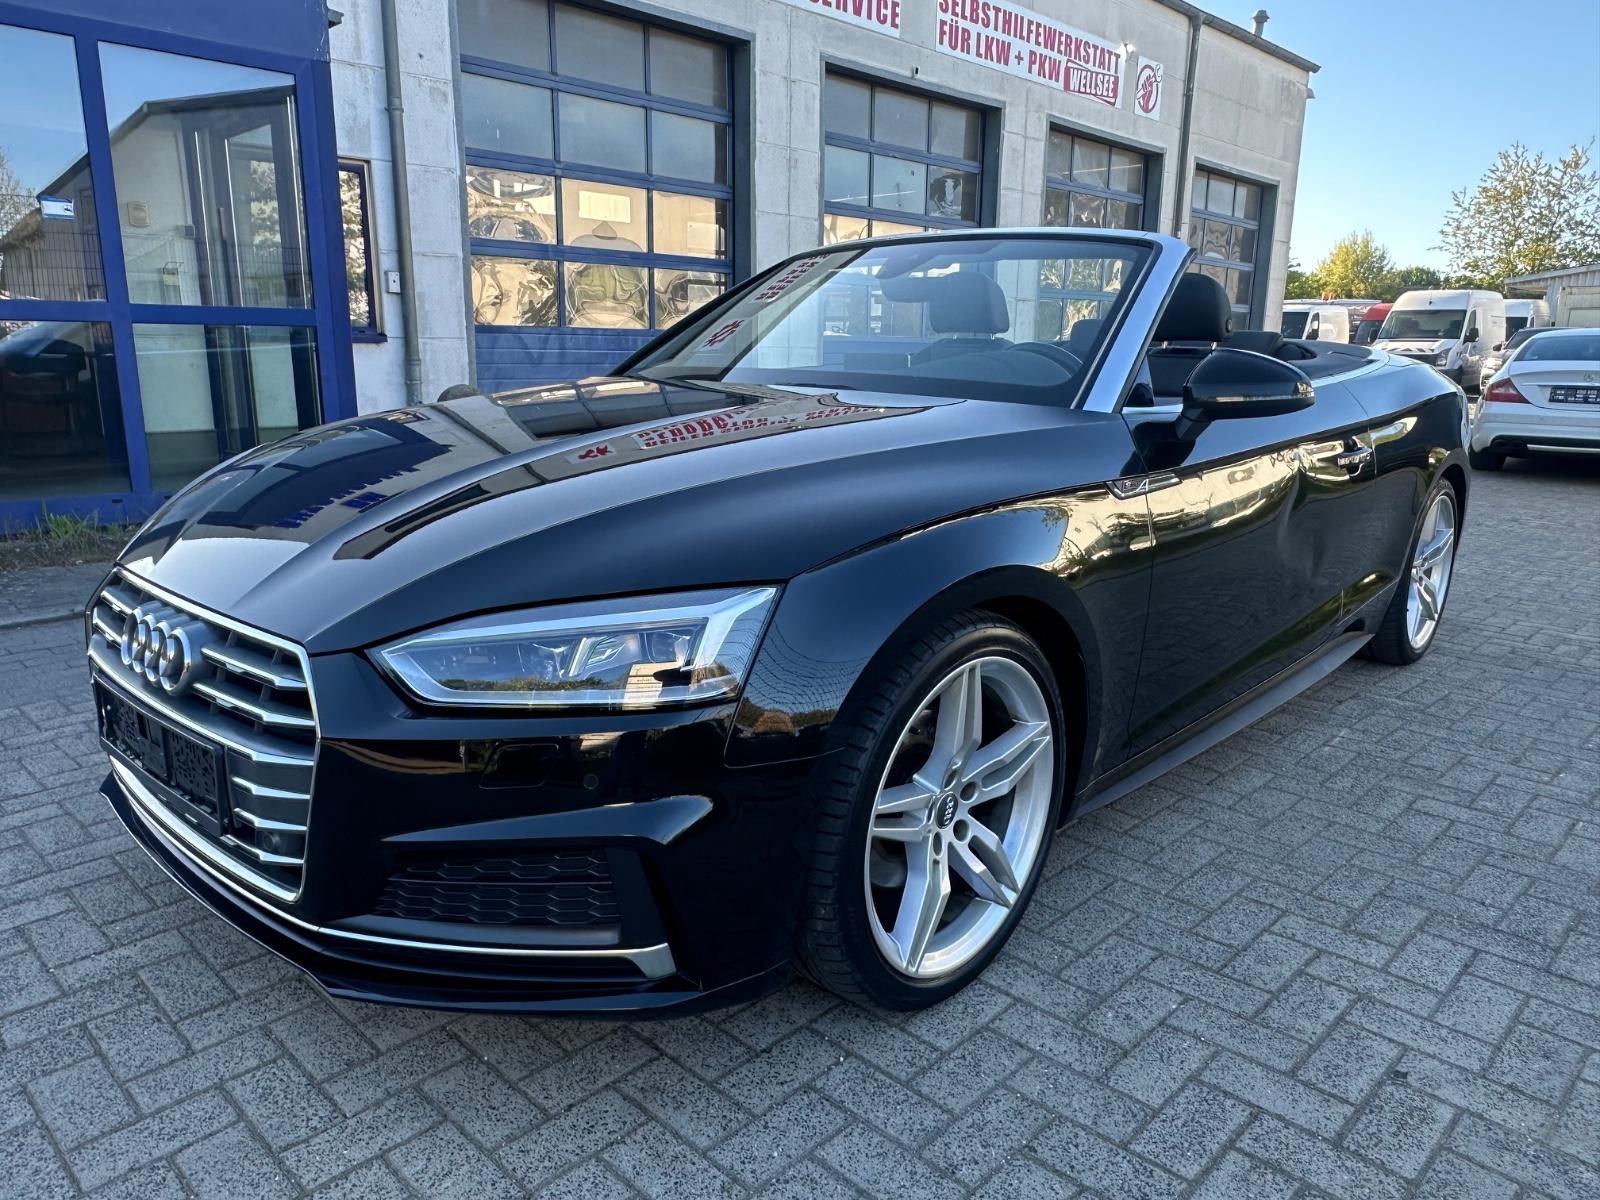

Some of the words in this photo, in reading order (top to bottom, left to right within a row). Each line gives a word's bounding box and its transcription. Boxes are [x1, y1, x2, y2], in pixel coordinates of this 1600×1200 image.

[809, 0, 900, 29] VICE
[938, 0, 1121, 75] SELBSTHILFEWERKSTATT
[938, 18, 972, 55] FÜR
[975, 31, 1012, 67] LKW
[1014, 50, 1024, 66] +
[1027, 49, 1062, 83] PKW
[1069, 68, 1116, 98] WELLSEE
